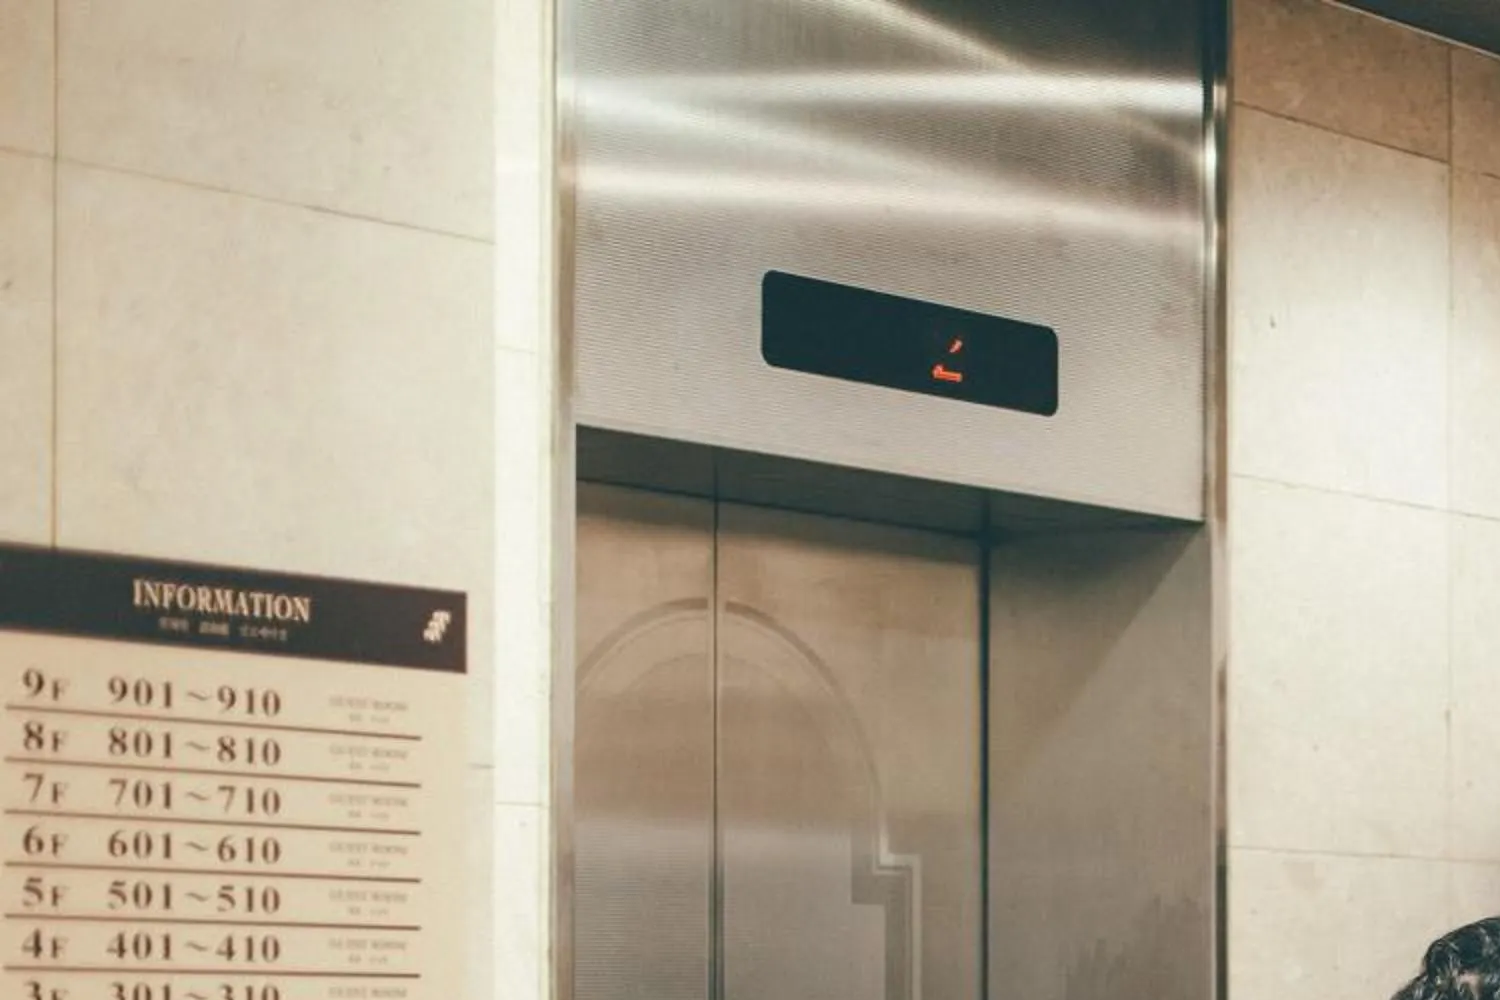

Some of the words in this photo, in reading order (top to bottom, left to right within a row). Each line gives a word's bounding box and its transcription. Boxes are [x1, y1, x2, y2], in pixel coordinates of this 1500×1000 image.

[132, 579, 311, 622] INFORMATION
[21, 668, 68, 700] 9F
[21, 720, 68, 752] 8F
[21, 773, 68, 804] 7F
[21, 825, 68, 857] 6F
[21, 876, 68, 907] 5F
[21, 928, 68, 960] 4F
